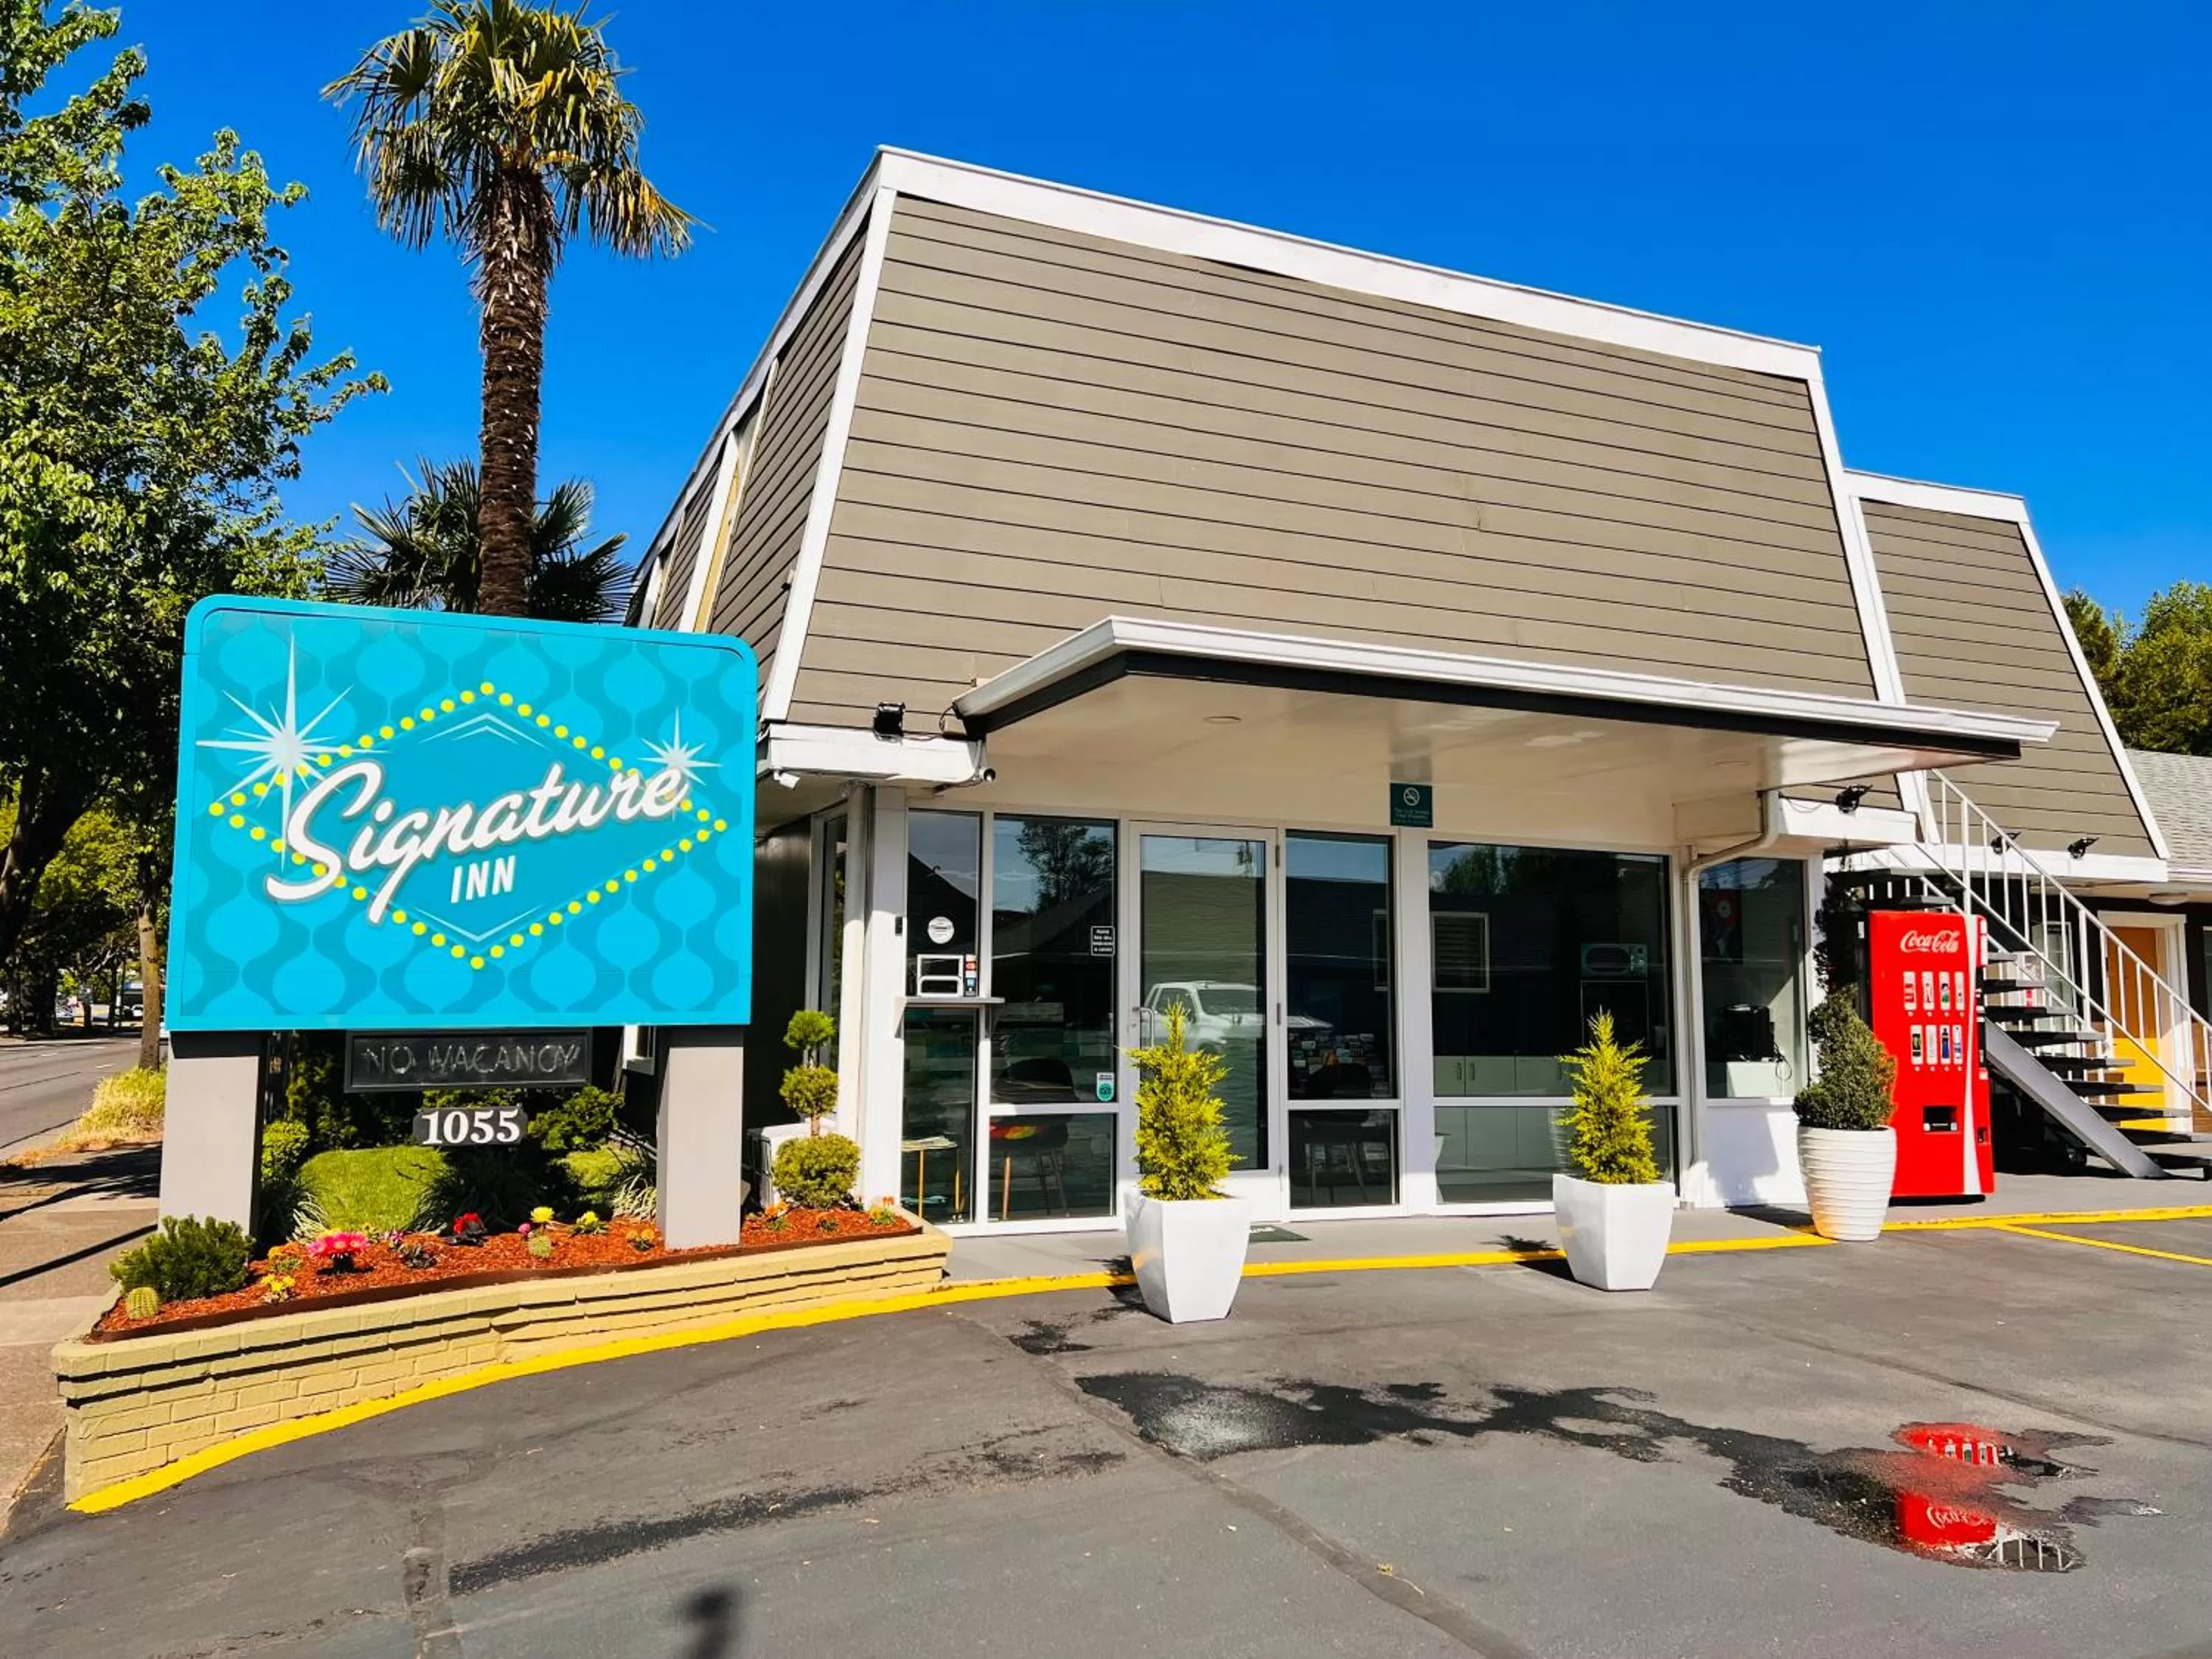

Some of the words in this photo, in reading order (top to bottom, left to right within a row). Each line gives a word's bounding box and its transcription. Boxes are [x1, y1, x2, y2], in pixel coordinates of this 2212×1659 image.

[266, 760, 690, 925] Signature
[449, 855, 516, 904] INN
[1900, 930, 1961, 953] Coca-Cola
[362, 1046, 417, 1074] NO
[421, 1109, 521, 1145] 1055
